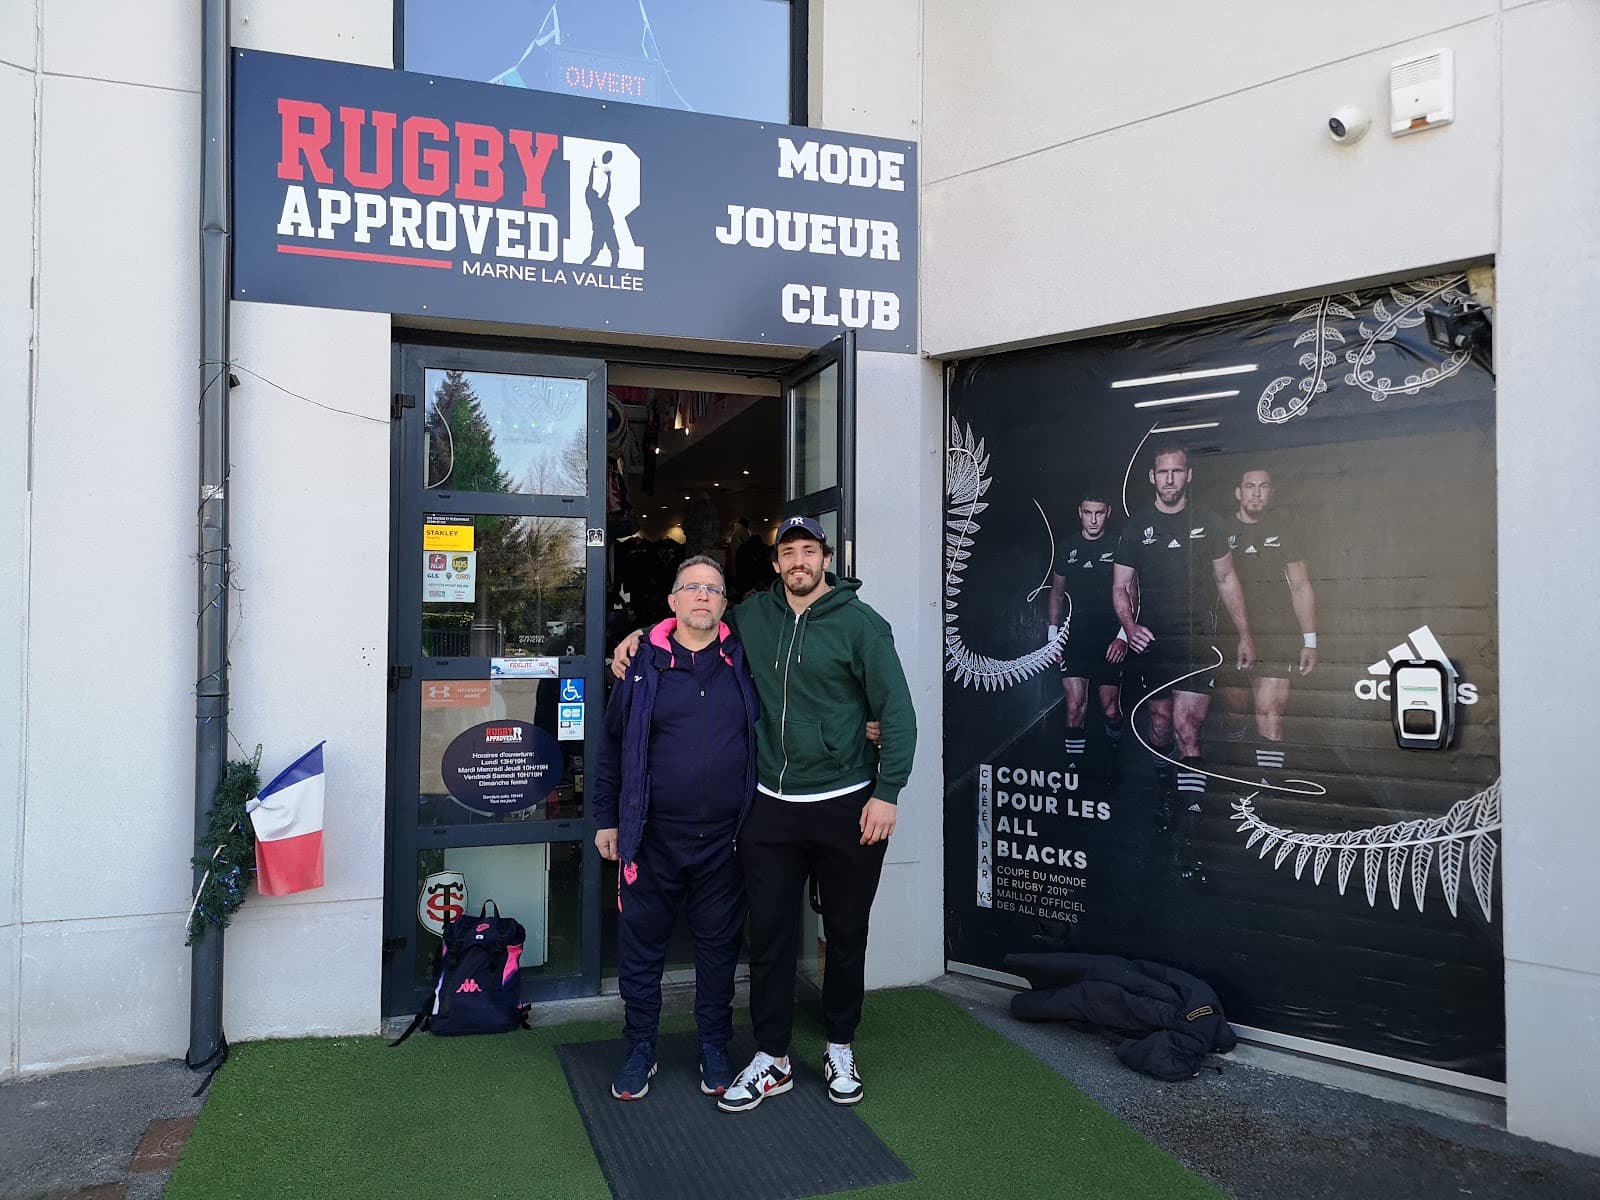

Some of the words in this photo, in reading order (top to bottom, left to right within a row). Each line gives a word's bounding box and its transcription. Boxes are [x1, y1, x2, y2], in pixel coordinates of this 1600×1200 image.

[565, 65, 646, 97] OUVERT
[277, 97, 559, 209] RUGBY
[777, 137, 905, 192] MODE
[276, 184, 559, 262] APPROVED
[715, 204, 901, 261] JOUEUR
[462, 260, 537, 282] MARNE
[541, 267, 568, 285] LA
[571, 271, 645, 292] VALLÉE
[781, 283, 900, 331] CLUB
[426, 529, 459, 537] STANLEY
[486, 727, 513, 736] RUGBY
[996, 766, 1079, 794] CONÇU
[996, 790, 1059, 815] POUR
[1067, 798, 1112, 821] LES
[996, 815, 1039, 837] ALL
[996, 839, 1088, 870] BLACKS
[996, 865, 1030, 879] COUPE
[1032, 870, 1047, 881] DU
[1049, 874, 1087, 888] MONDE
[996, 877, 1009, 887] DE
[1011, 879, 1044, 892] RUGBY
[996, 889, 1038, 903] MAILLOT
[1040, 896, 1087, 913] OFFICIEL
[996, 900, 1016, 912] DES
[1018, 904, 1036, 916] ALL
[1038, 907, 1079, 924] BLACKS
